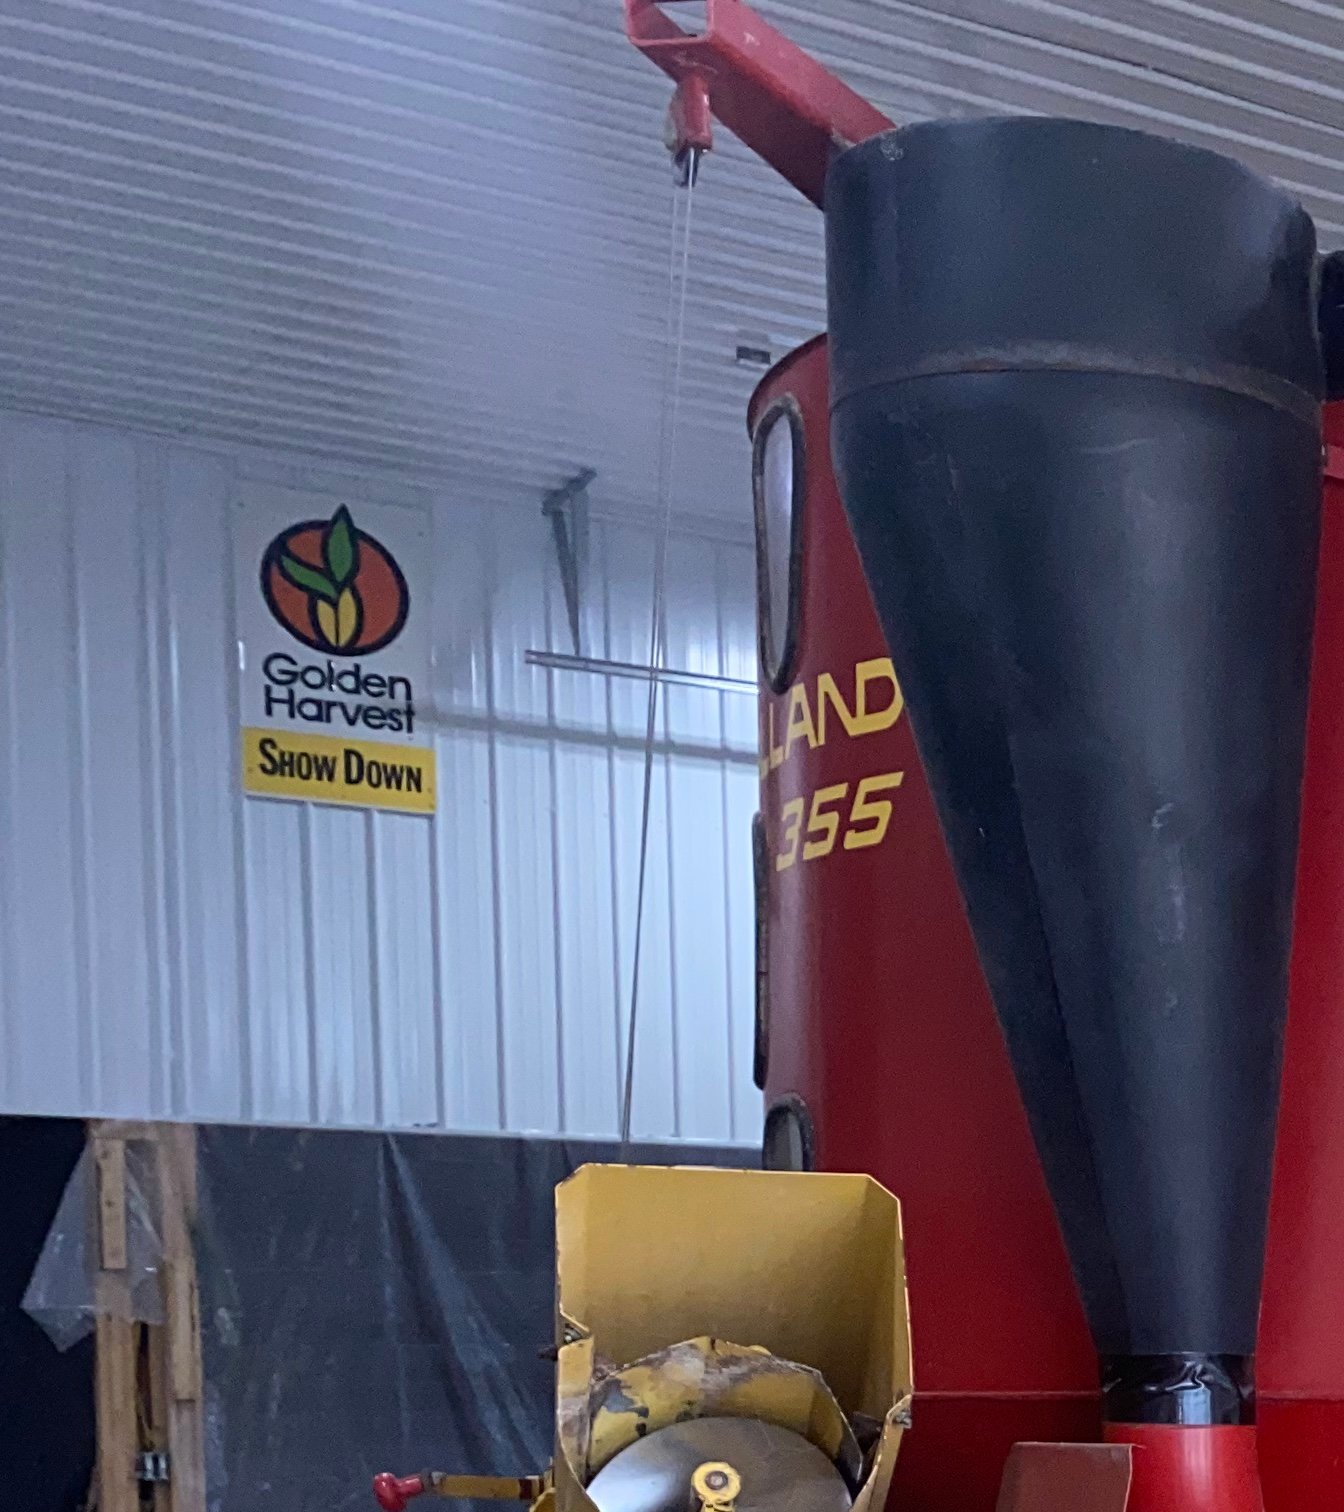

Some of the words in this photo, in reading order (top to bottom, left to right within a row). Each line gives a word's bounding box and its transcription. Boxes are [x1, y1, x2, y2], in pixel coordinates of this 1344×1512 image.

[263, 653, 412, 699] Golden
[264, 685, 415, 733] Harvest
[759, 657, 904, 781] LAND
[776, 771, 904, 871] 355
